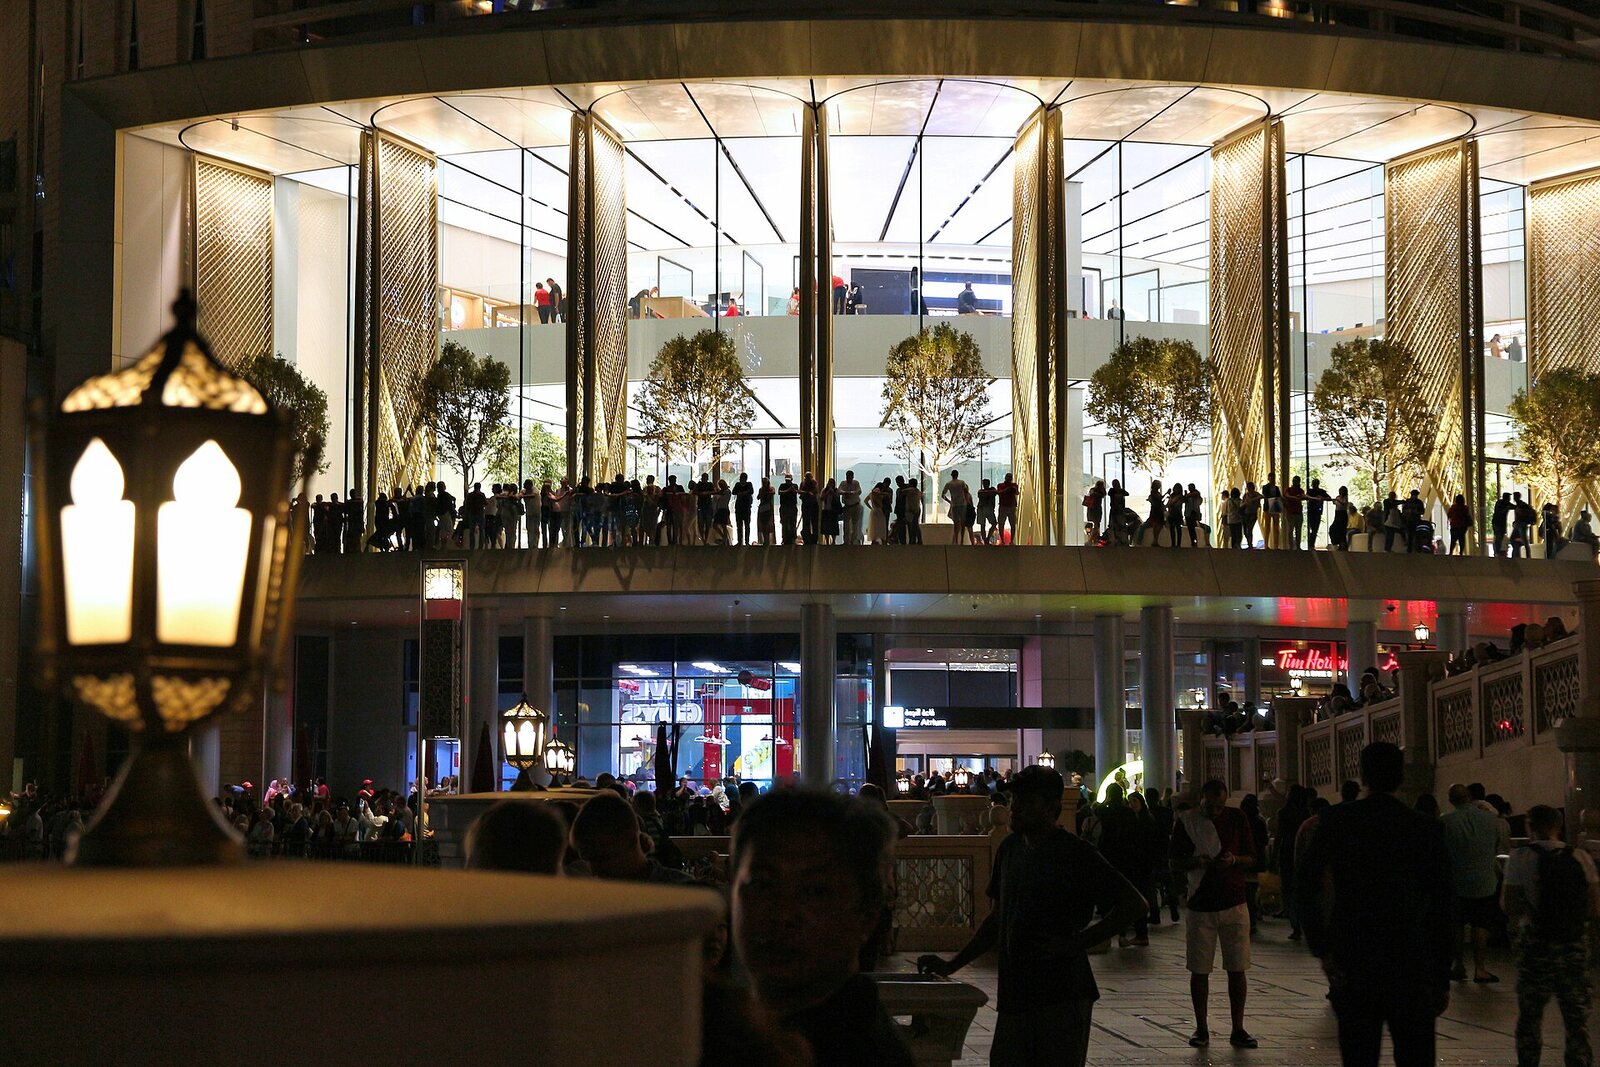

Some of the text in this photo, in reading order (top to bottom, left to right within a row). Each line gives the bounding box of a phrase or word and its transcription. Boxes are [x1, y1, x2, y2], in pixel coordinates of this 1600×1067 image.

[1278, 649, 1304, 669] Tim
[905, 718, 947, 726] Star Atrium
